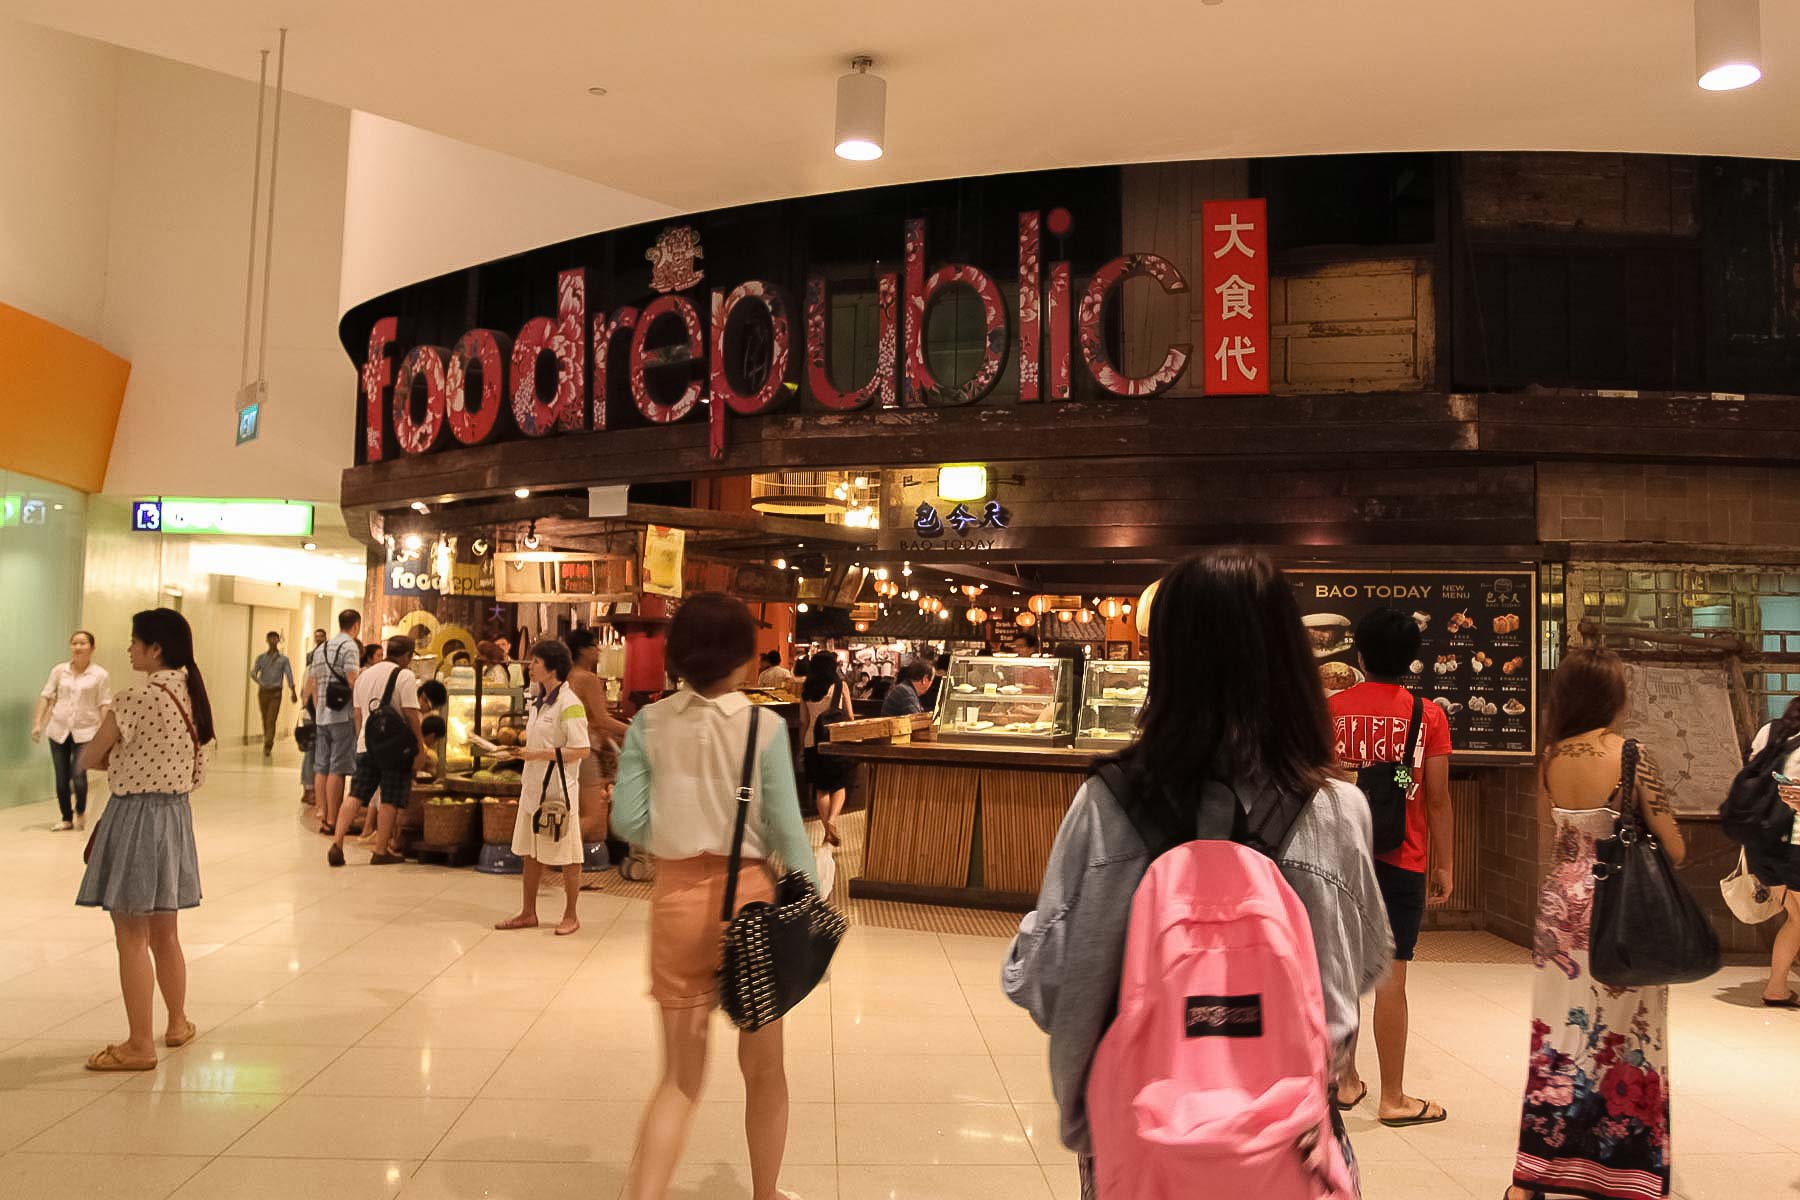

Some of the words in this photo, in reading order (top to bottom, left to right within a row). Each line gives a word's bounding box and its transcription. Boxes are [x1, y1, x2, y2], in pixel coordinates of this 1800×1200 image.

[1213, 213, 1257, 382] 大食代
[136, 503, 160, 529] L3
[914, 500, 1008, 537] 包今天
[900, 539, 932, 551] BAO
[943, 539, 995, 551] TODAY
[1315, 584, 1358, 598] BAO
[1363, 584, 1432, 598] TODAY
[1442, 584, 1465, 592] NEW
